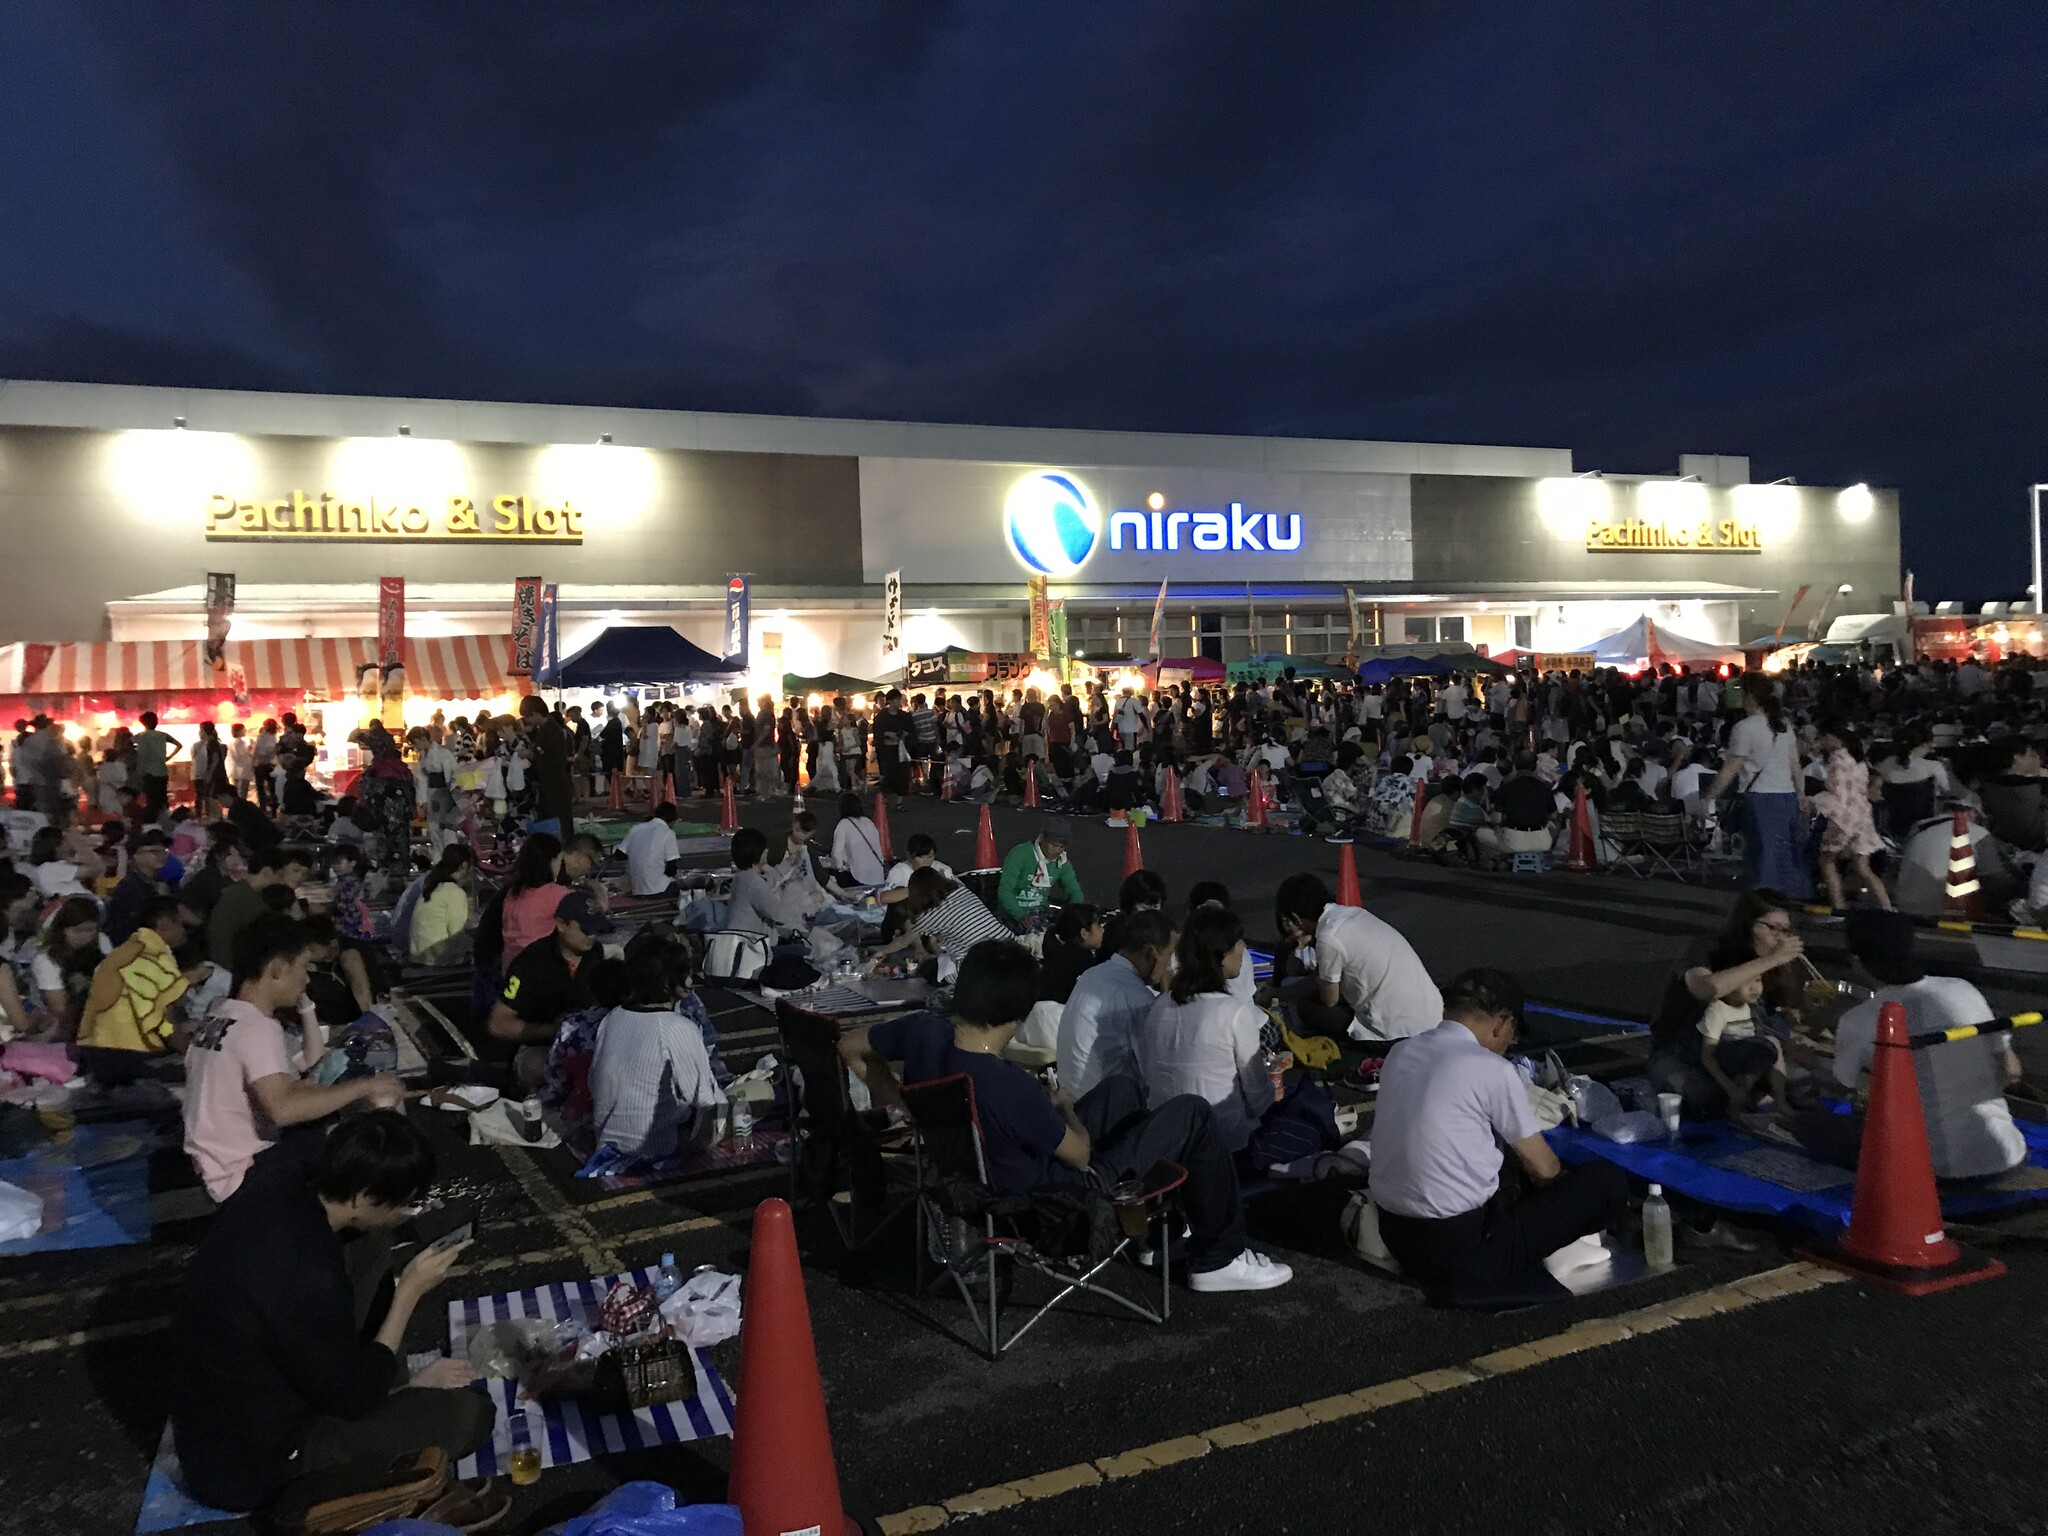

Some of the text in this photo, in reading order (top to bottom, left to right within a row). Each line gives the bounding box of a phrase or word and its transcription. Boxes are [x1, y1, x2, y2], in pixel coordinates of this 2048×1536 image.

[206, 489, 583, 535] Pachinko & Slot
[1109, 491, 1302, 552] niraku
[1586, 517, 1690, 547] Pachinko
[1718, 518, 1762, 547] Slot
[909, 656, 947, 678] タコス
